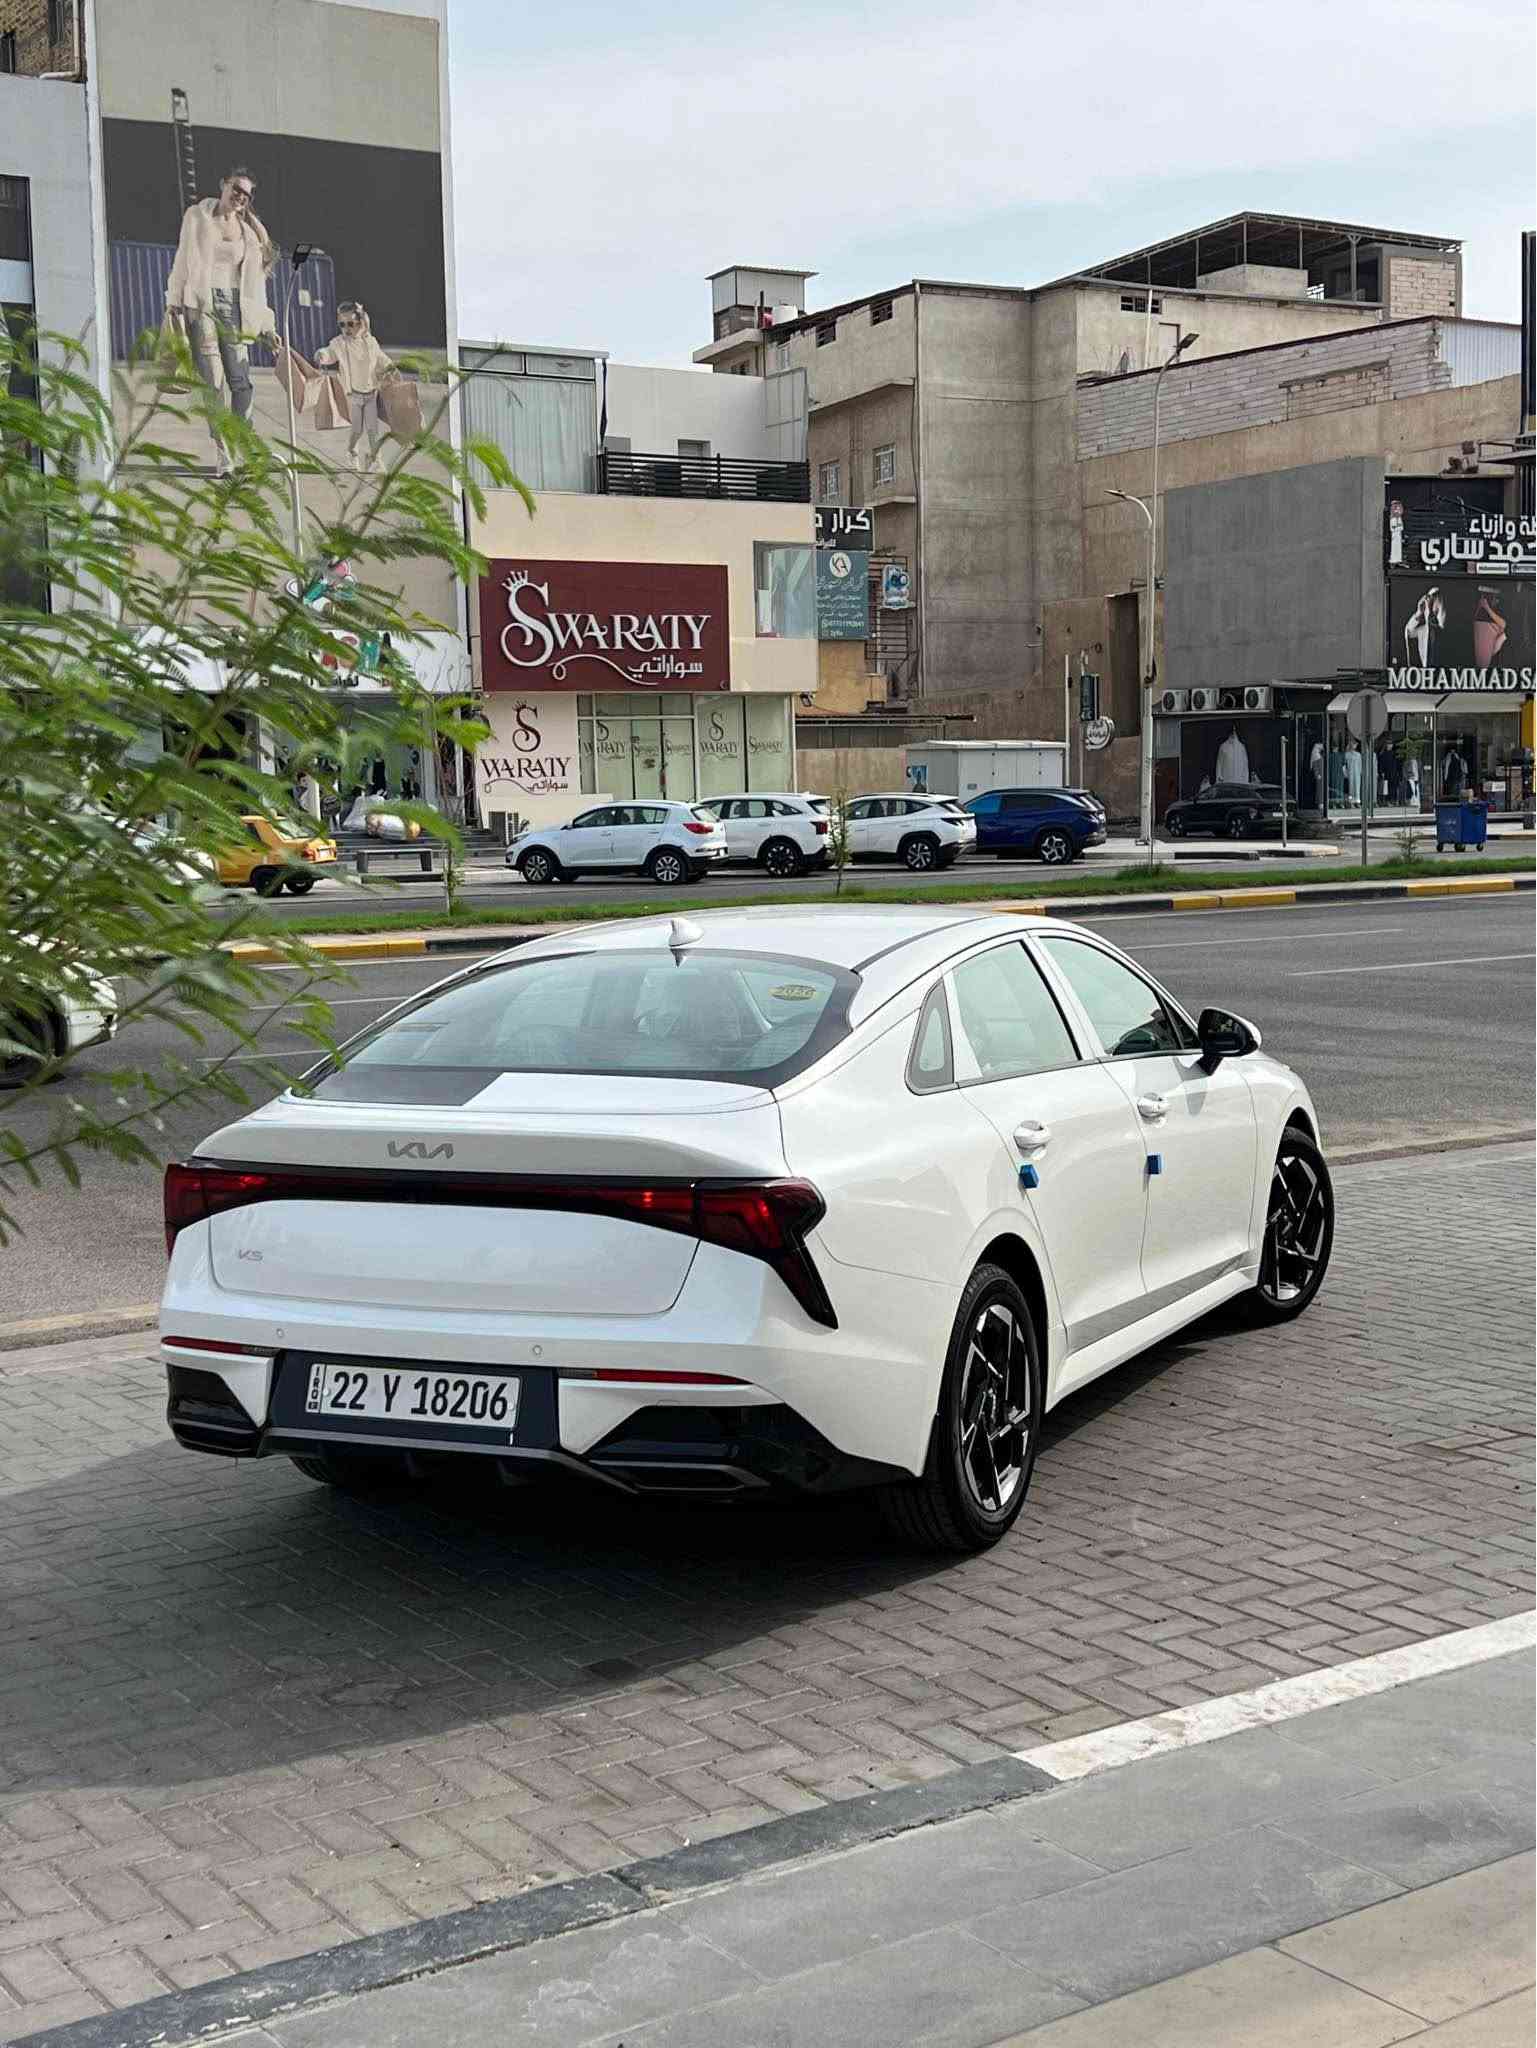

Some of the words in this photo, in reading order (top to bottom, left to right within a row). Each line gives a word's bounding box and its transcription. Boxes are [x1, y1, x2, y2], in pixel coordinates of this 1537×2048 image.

[831, 508, 871, 534] كرار
[1421, 532, 1485, 571] ساري
[501, 571, 712, 667] SWARATY
[627, 654, 704, 679] سواراتي
[1387, 667, 1518, 690] MOHAMMAD
[480, 757, 571, 779] WARATY
[330, 1371, 368, 1410] 22
[384, 1374, 401, 1413] Y
[410, 1377, 508, 1421] 18206
